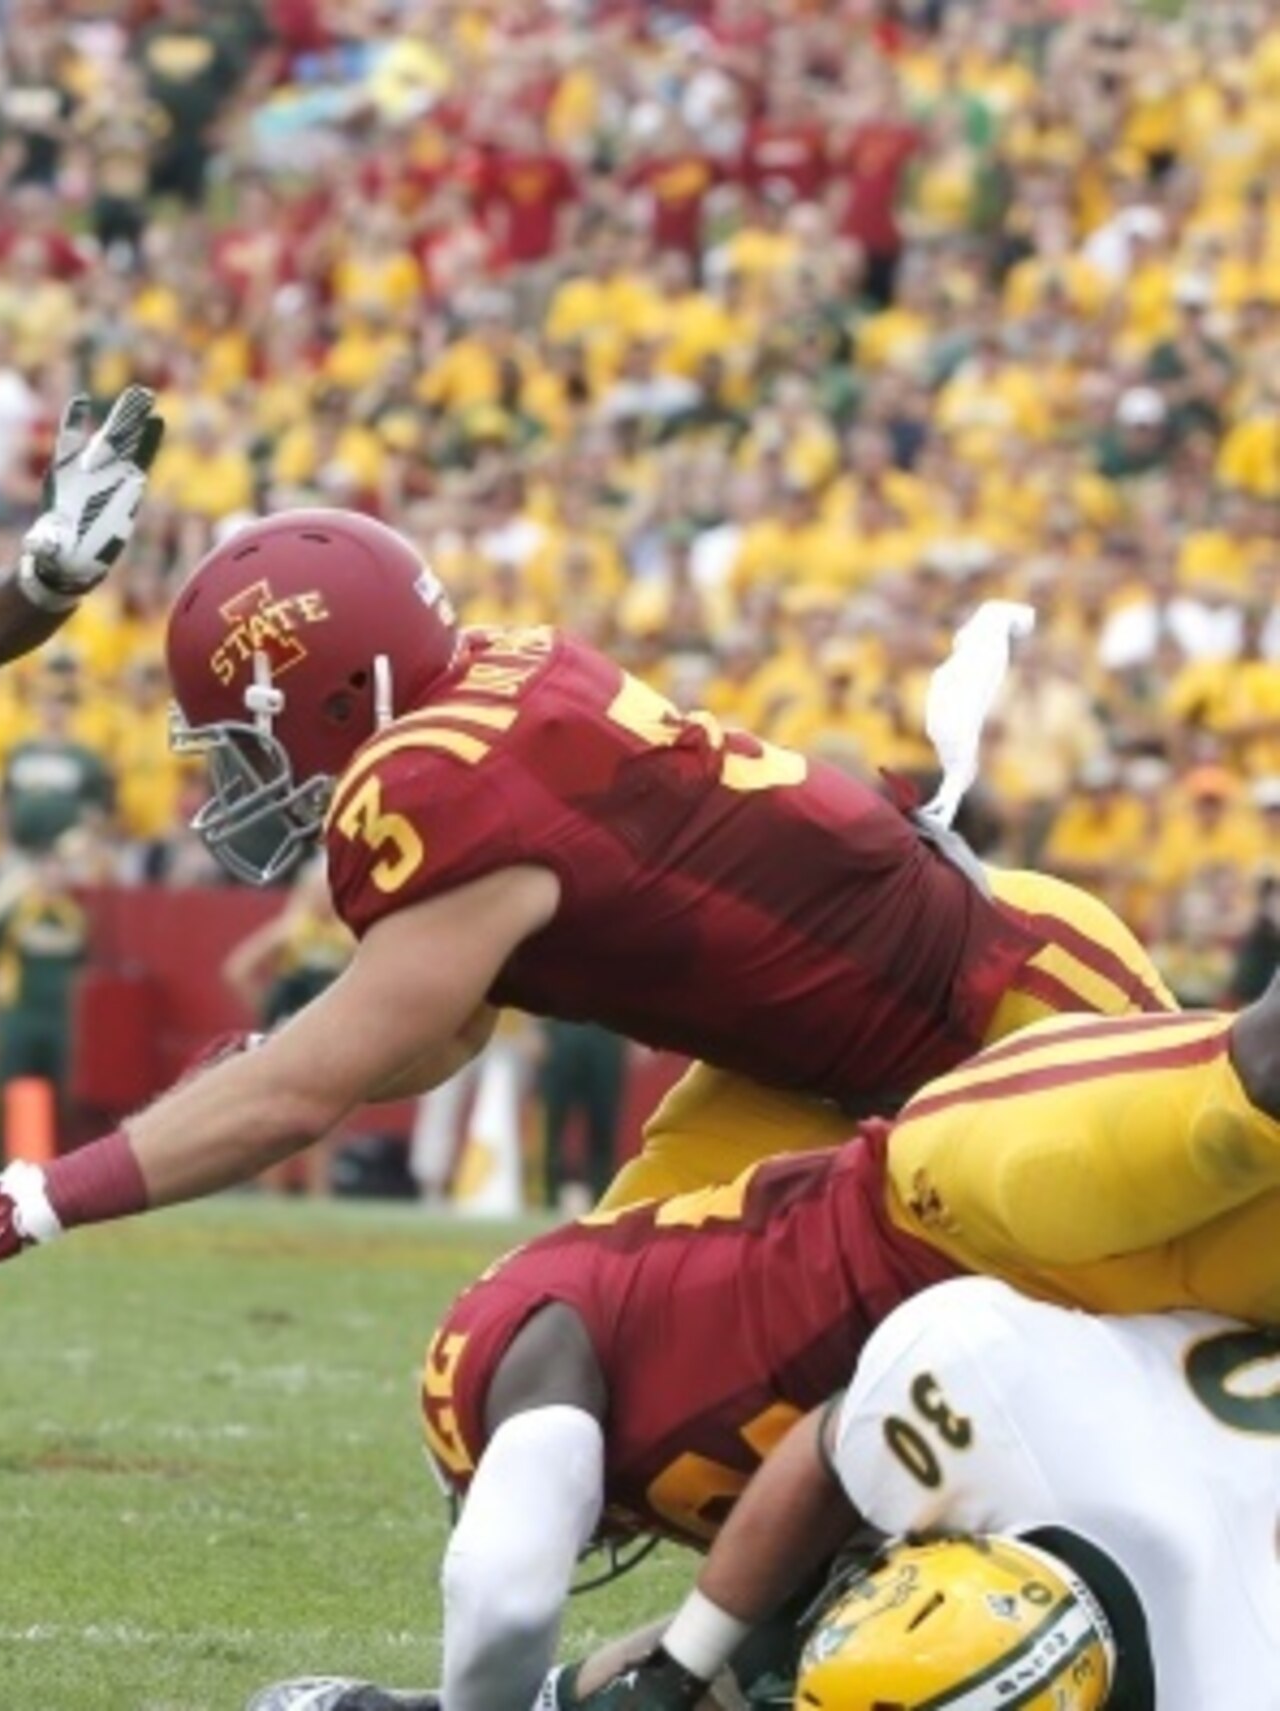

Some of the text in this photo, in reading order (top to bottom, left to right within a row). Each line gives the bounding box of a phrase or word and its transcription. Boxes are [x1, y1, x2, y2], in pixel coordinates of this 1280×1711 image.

[210, 591, 328, 686] STATE
[337, 775, 423, 893] 3
[883, 1371, 972, 1488] 30
